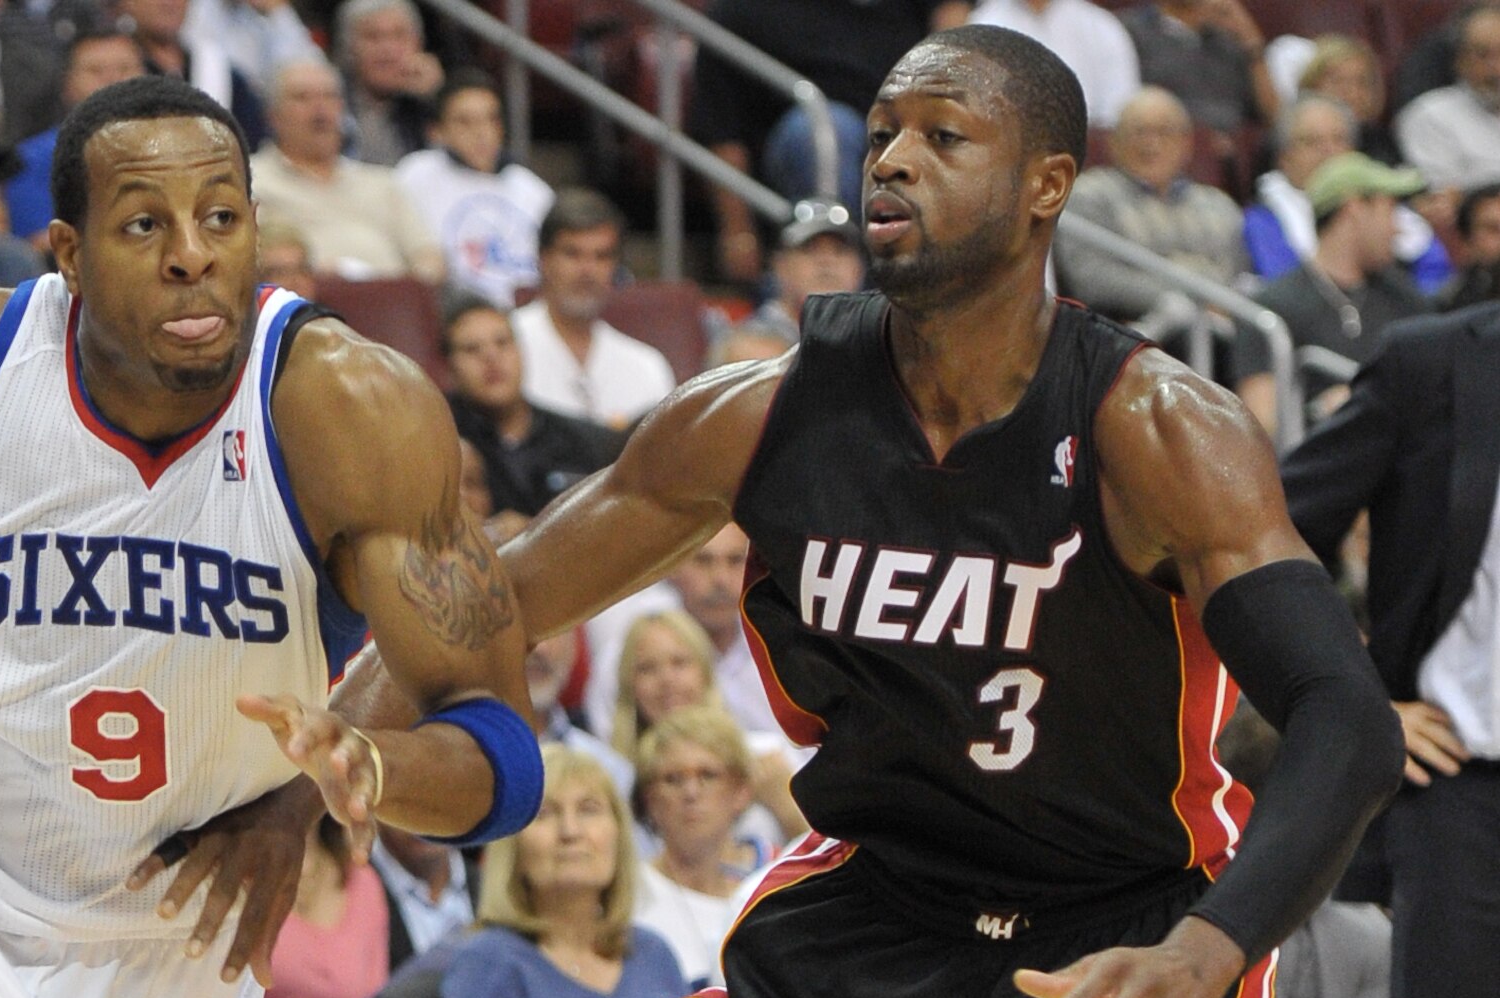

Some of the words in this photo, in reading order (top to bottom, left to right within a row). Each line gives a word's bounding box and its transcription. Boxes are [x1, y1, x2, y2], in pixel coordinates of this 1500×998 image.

[800, 530, 1082, 650] HEAT
[69, 688, 169, 802] 9
[968, 667, 1044, 771] 3
